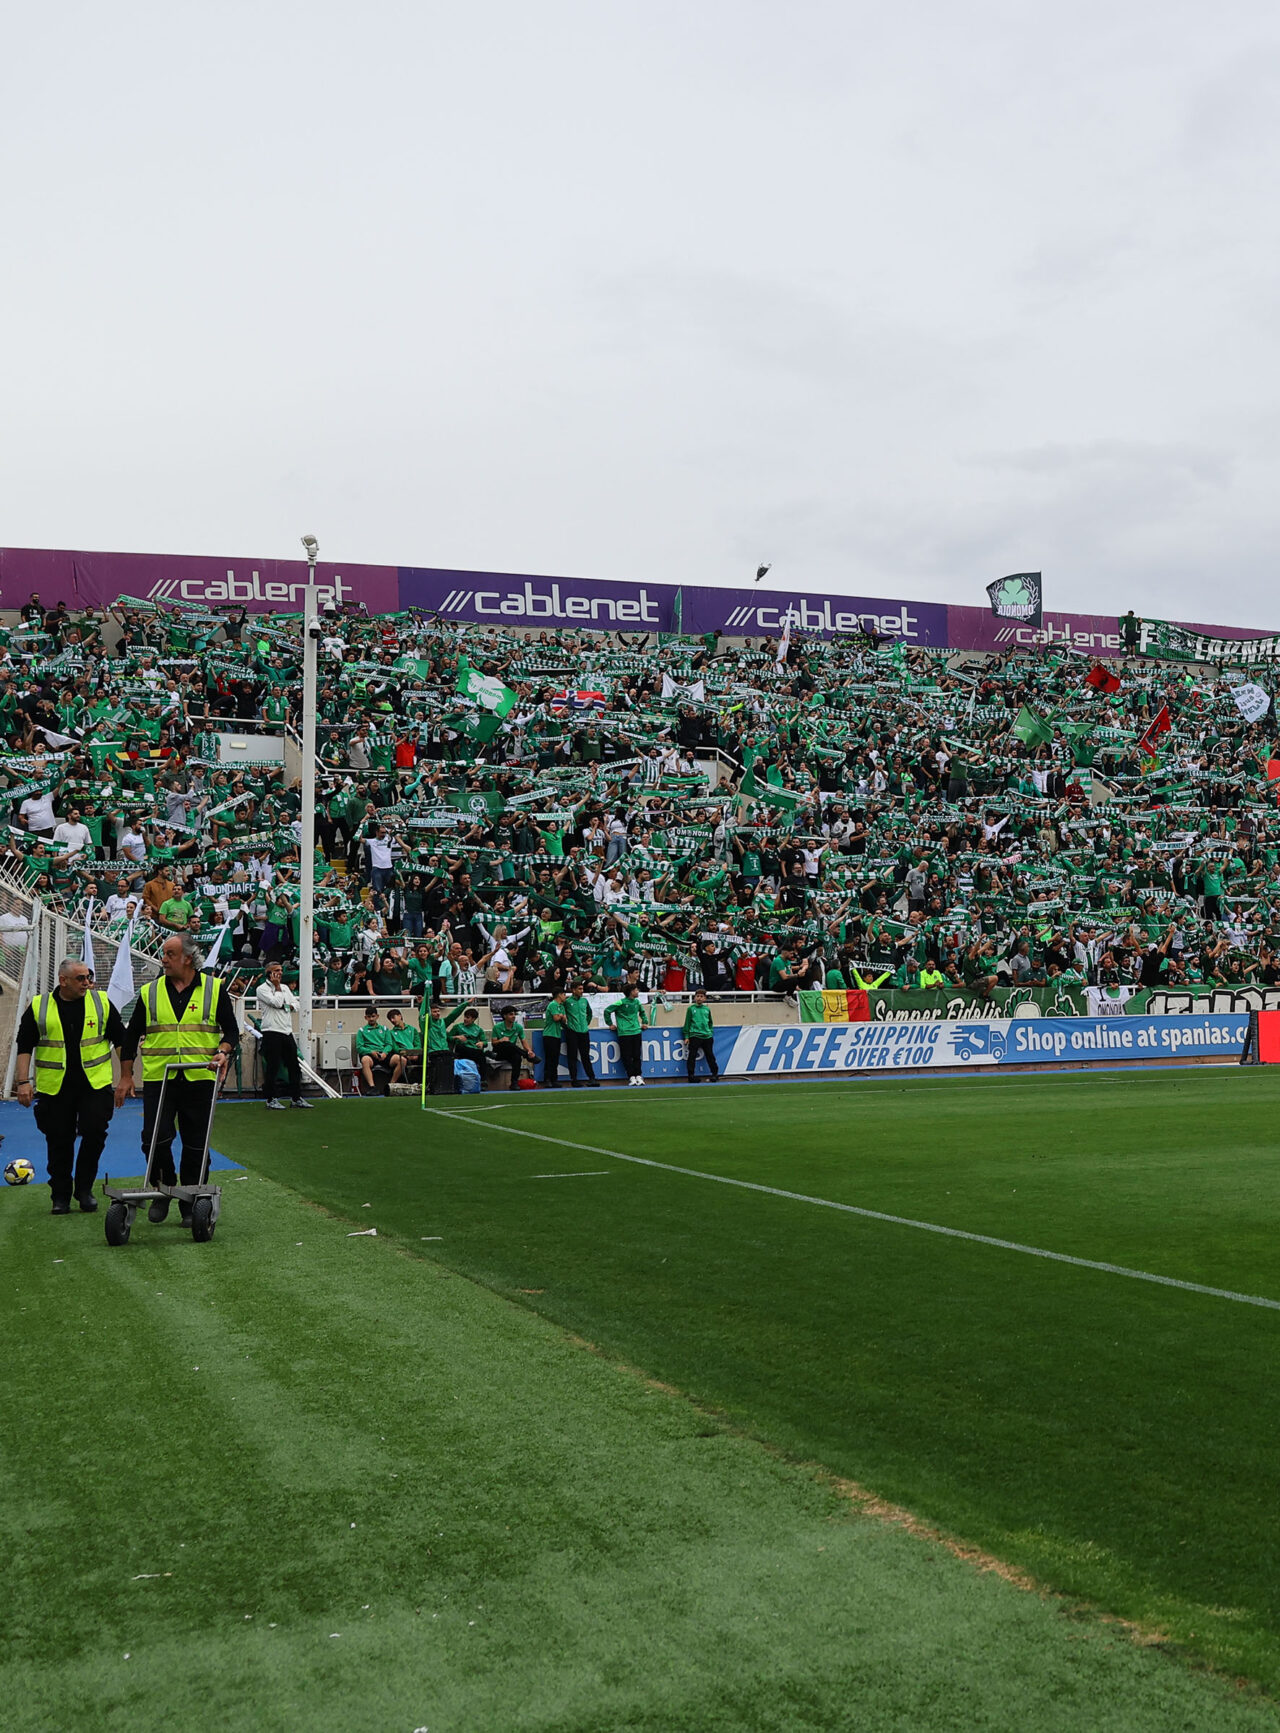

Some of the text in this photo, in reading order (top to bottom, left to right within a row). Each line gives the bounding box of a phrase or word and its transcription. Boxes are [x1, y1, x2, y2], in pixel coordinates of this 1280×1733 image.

[474, 582, 660, 622] cablenet
[756, 599, 918, 637] cablenet
[1016, 622, 1120, 649] cablene
[412, 862, 435, 874] YEARS
[634, 942, 668, 951] OMONOIA
[850, 1024, 942, 1047] SHIPPING
[1015, 1026, 1067, 1056] Shop
[1071, 1024, 1132, 1049] online
[1136, 1026, 1158, 1047] at
[747, 1027, 848, 1072] FREE
[844, 1047, 892, 1068] OVER
[892, 1046, 935, 1066] €100
